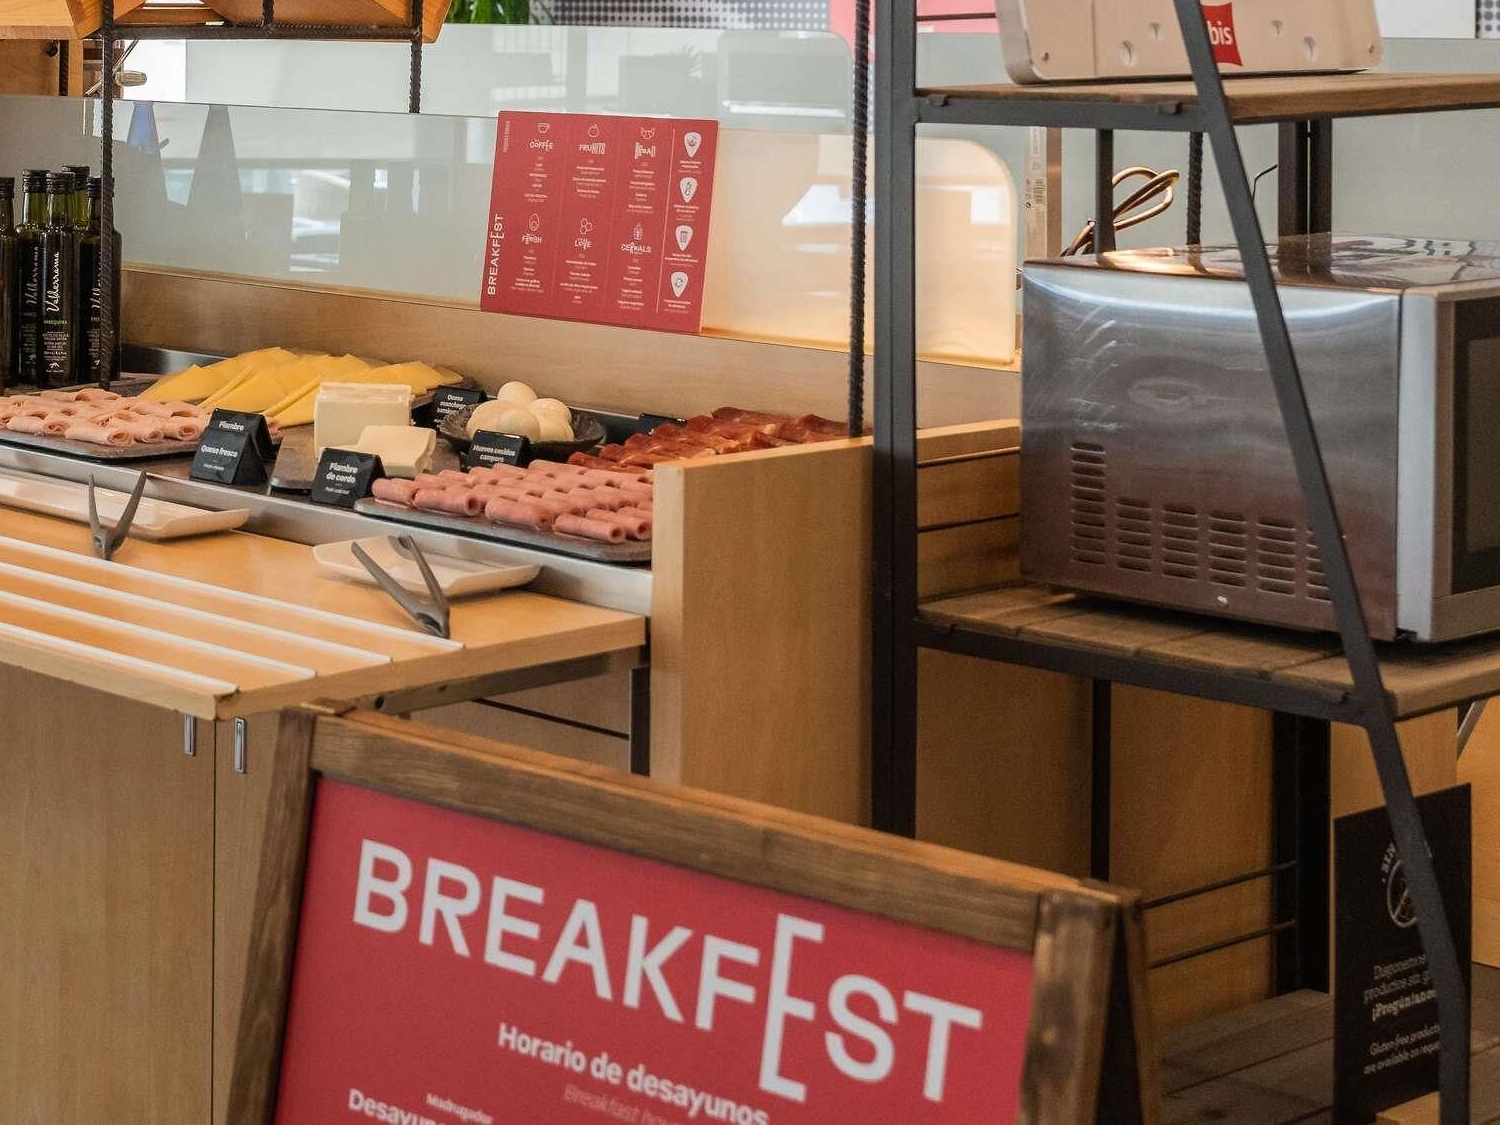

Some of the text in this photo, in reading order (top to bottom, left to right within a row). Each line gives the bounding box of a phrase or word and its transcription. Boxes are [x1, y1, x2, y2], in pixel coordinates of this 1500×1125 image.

[1206, 20, 1234, 45] bis
[487, 213, 505, 296] BREAKFEST
[46, 251, 60, 312] Valderrama
[218, 420, 245, 431] Fiambre
[200, 444, 238, 458] Queso fresco
[325, 471, 336, 480] de
[329, 462, 359, 474] Fiambre
[351, 837, 984, 1103] BREAKFEST
[497, 1021, 770, 1125] Horario de desayunos
[348, 1087, 445, 1125] Desayu
